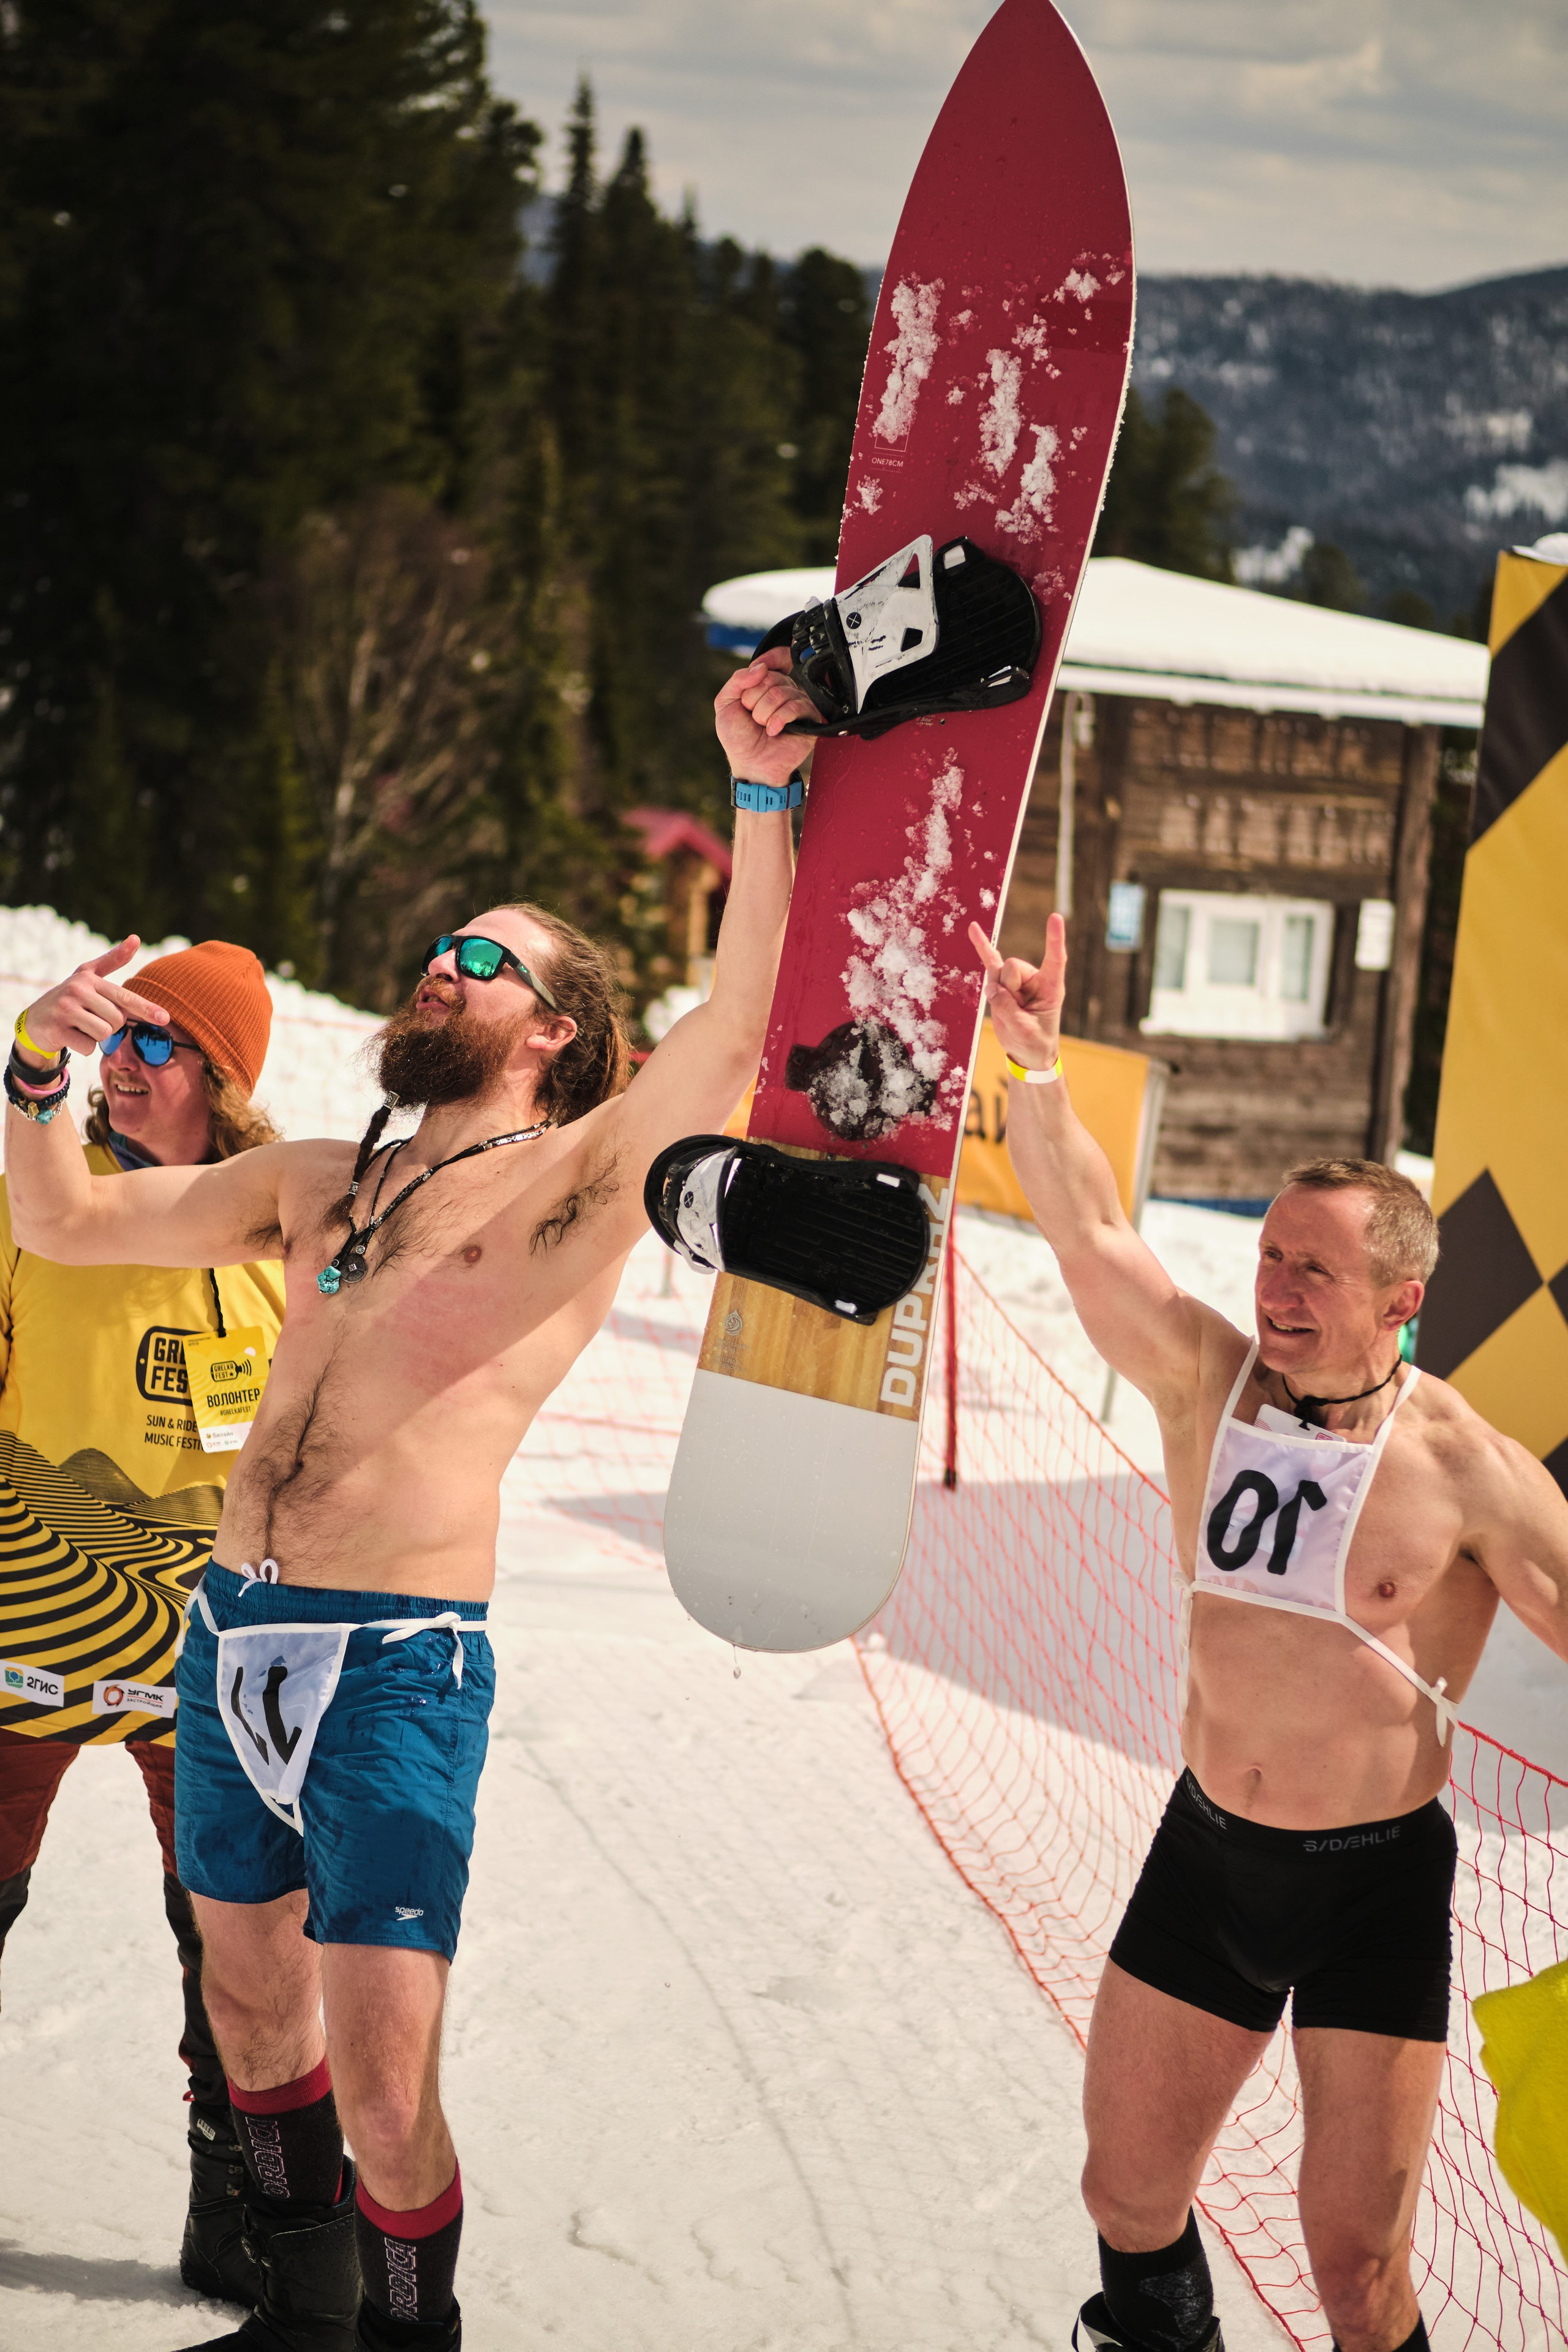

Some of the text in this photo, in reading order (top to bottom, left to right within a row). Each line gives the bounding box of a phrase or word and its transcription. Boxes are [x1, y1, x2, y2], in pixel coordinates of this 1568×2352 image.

[872, 457, 903, 467] ONE78CM
[151, 1365, 189, 1393] FES
[207, 1388, 260, 1408] ВОЛОНТЕР
[220, 1406, 251, 1416] #GRELKAFEST
[146, 1414, 198, 1433] SUN & RIDE
[144, 1431, 204, 1451] MUSIC FESTI
[27, 1676, 59, 1695] 2ГИС
[126, 1698, 163, 1709] ЗАСТРОЙЩИК
[127, 1689, 164, 1702] УГМК
[395, 1906, 424, 1916] speedo
[245, 2116, 290, 2198] ORDICA
